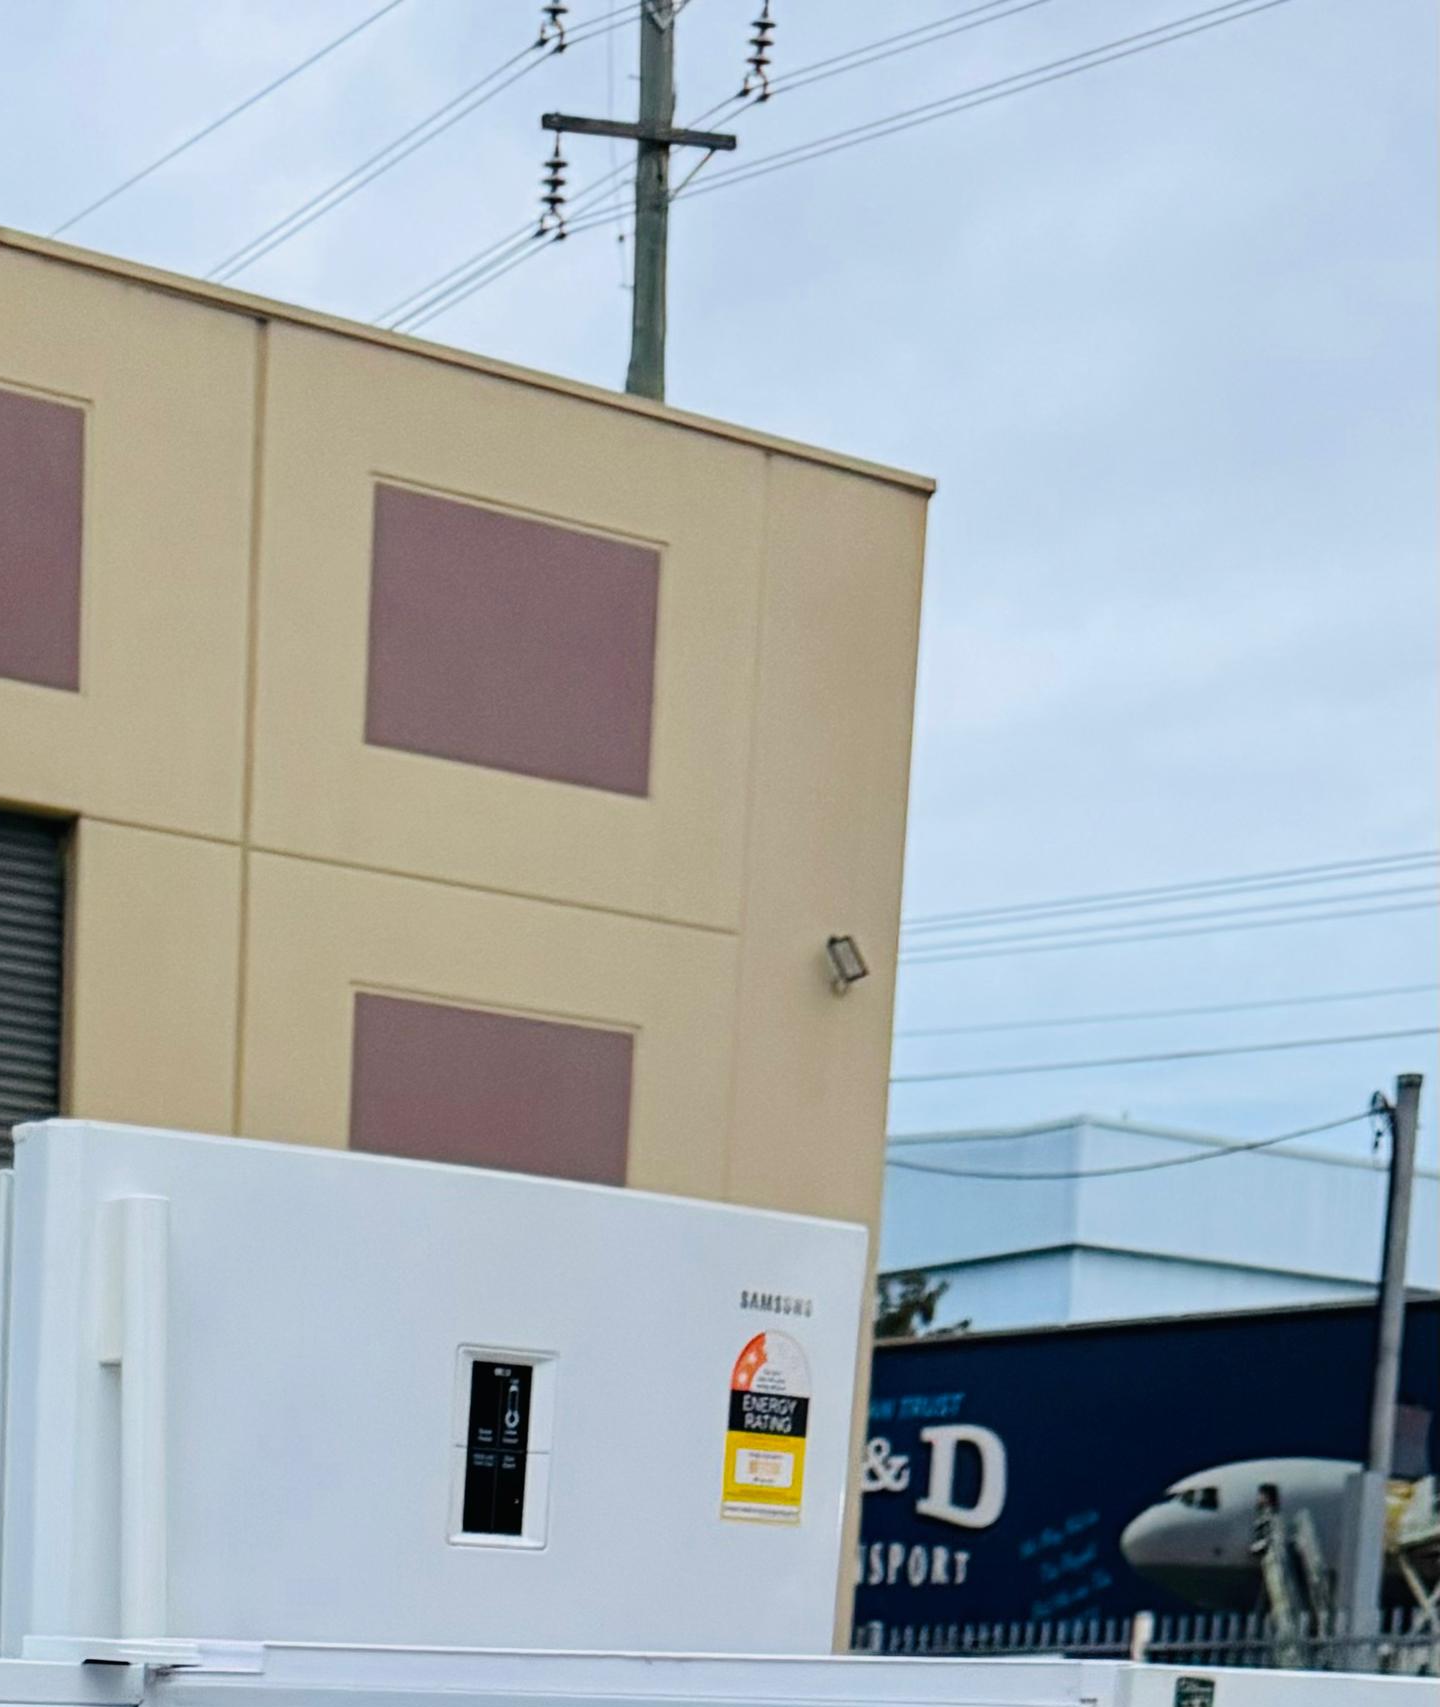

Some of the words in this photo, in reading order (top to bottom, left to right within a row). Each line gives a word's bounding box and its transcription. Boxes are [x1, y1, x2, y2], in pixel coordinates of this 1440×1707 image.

[740, 1290, 813, 1318] SAMSUNG
[742, 1394, 798, 1416] ENERGY
[744, 1413, 792, 1434] RATING
[915, 1424, 1008, 1530] D
